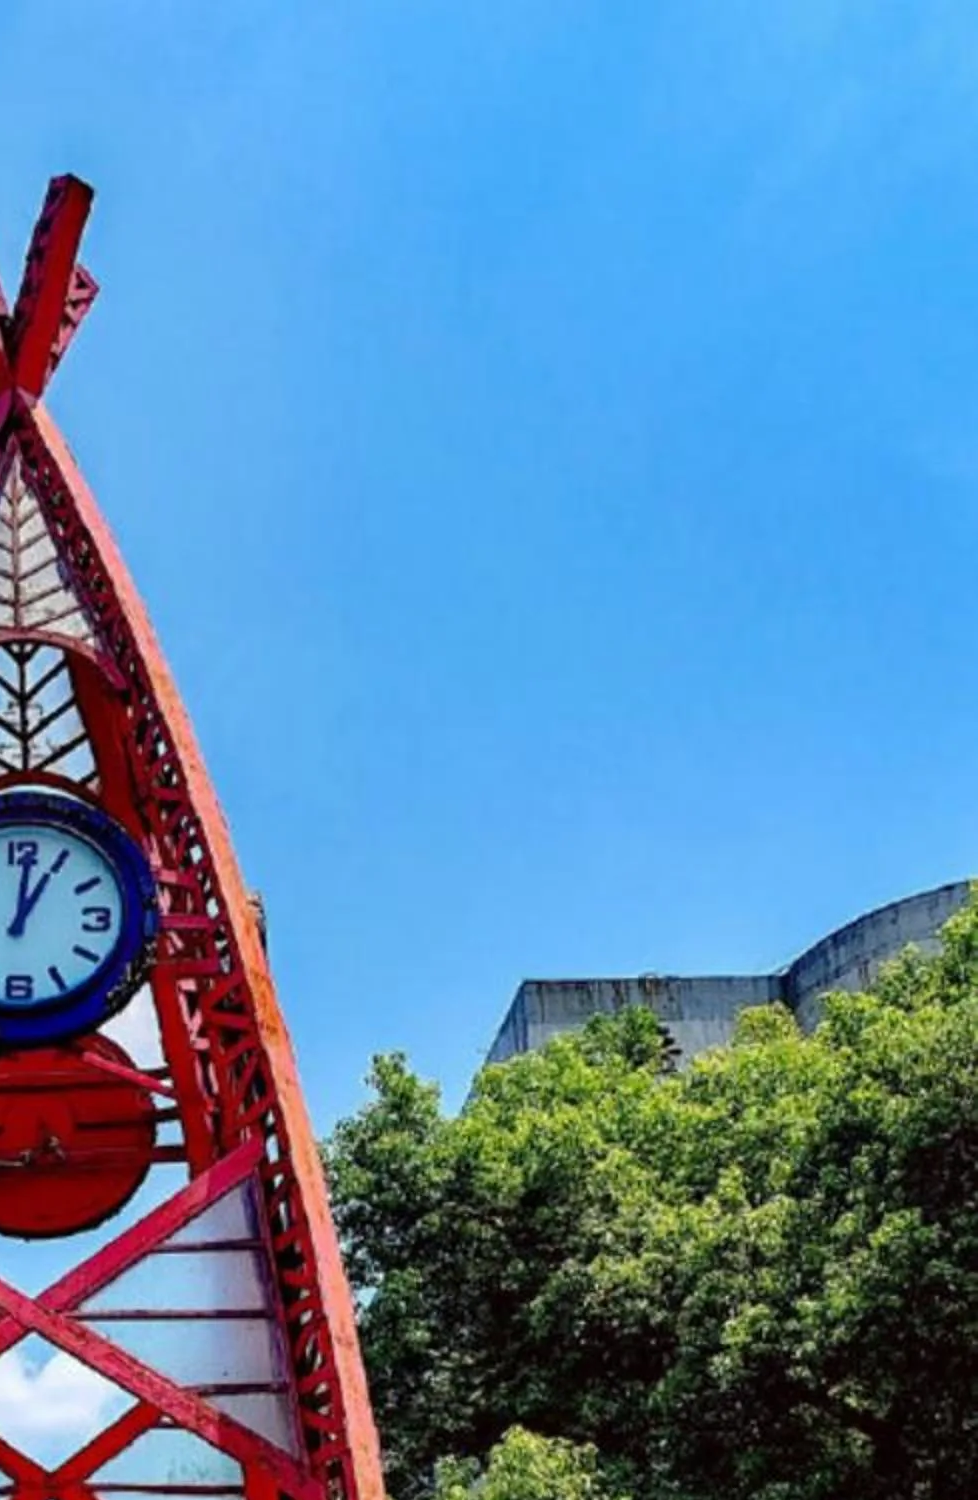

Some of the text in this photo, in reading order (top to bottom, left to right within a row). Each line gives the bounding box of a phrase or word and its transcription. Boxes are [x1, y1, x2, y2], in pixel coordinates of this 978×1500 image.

[7, 841, 38, 866] 12
[82, 907, 111, 932] 3
[5, 975, 33, 1000] 6
